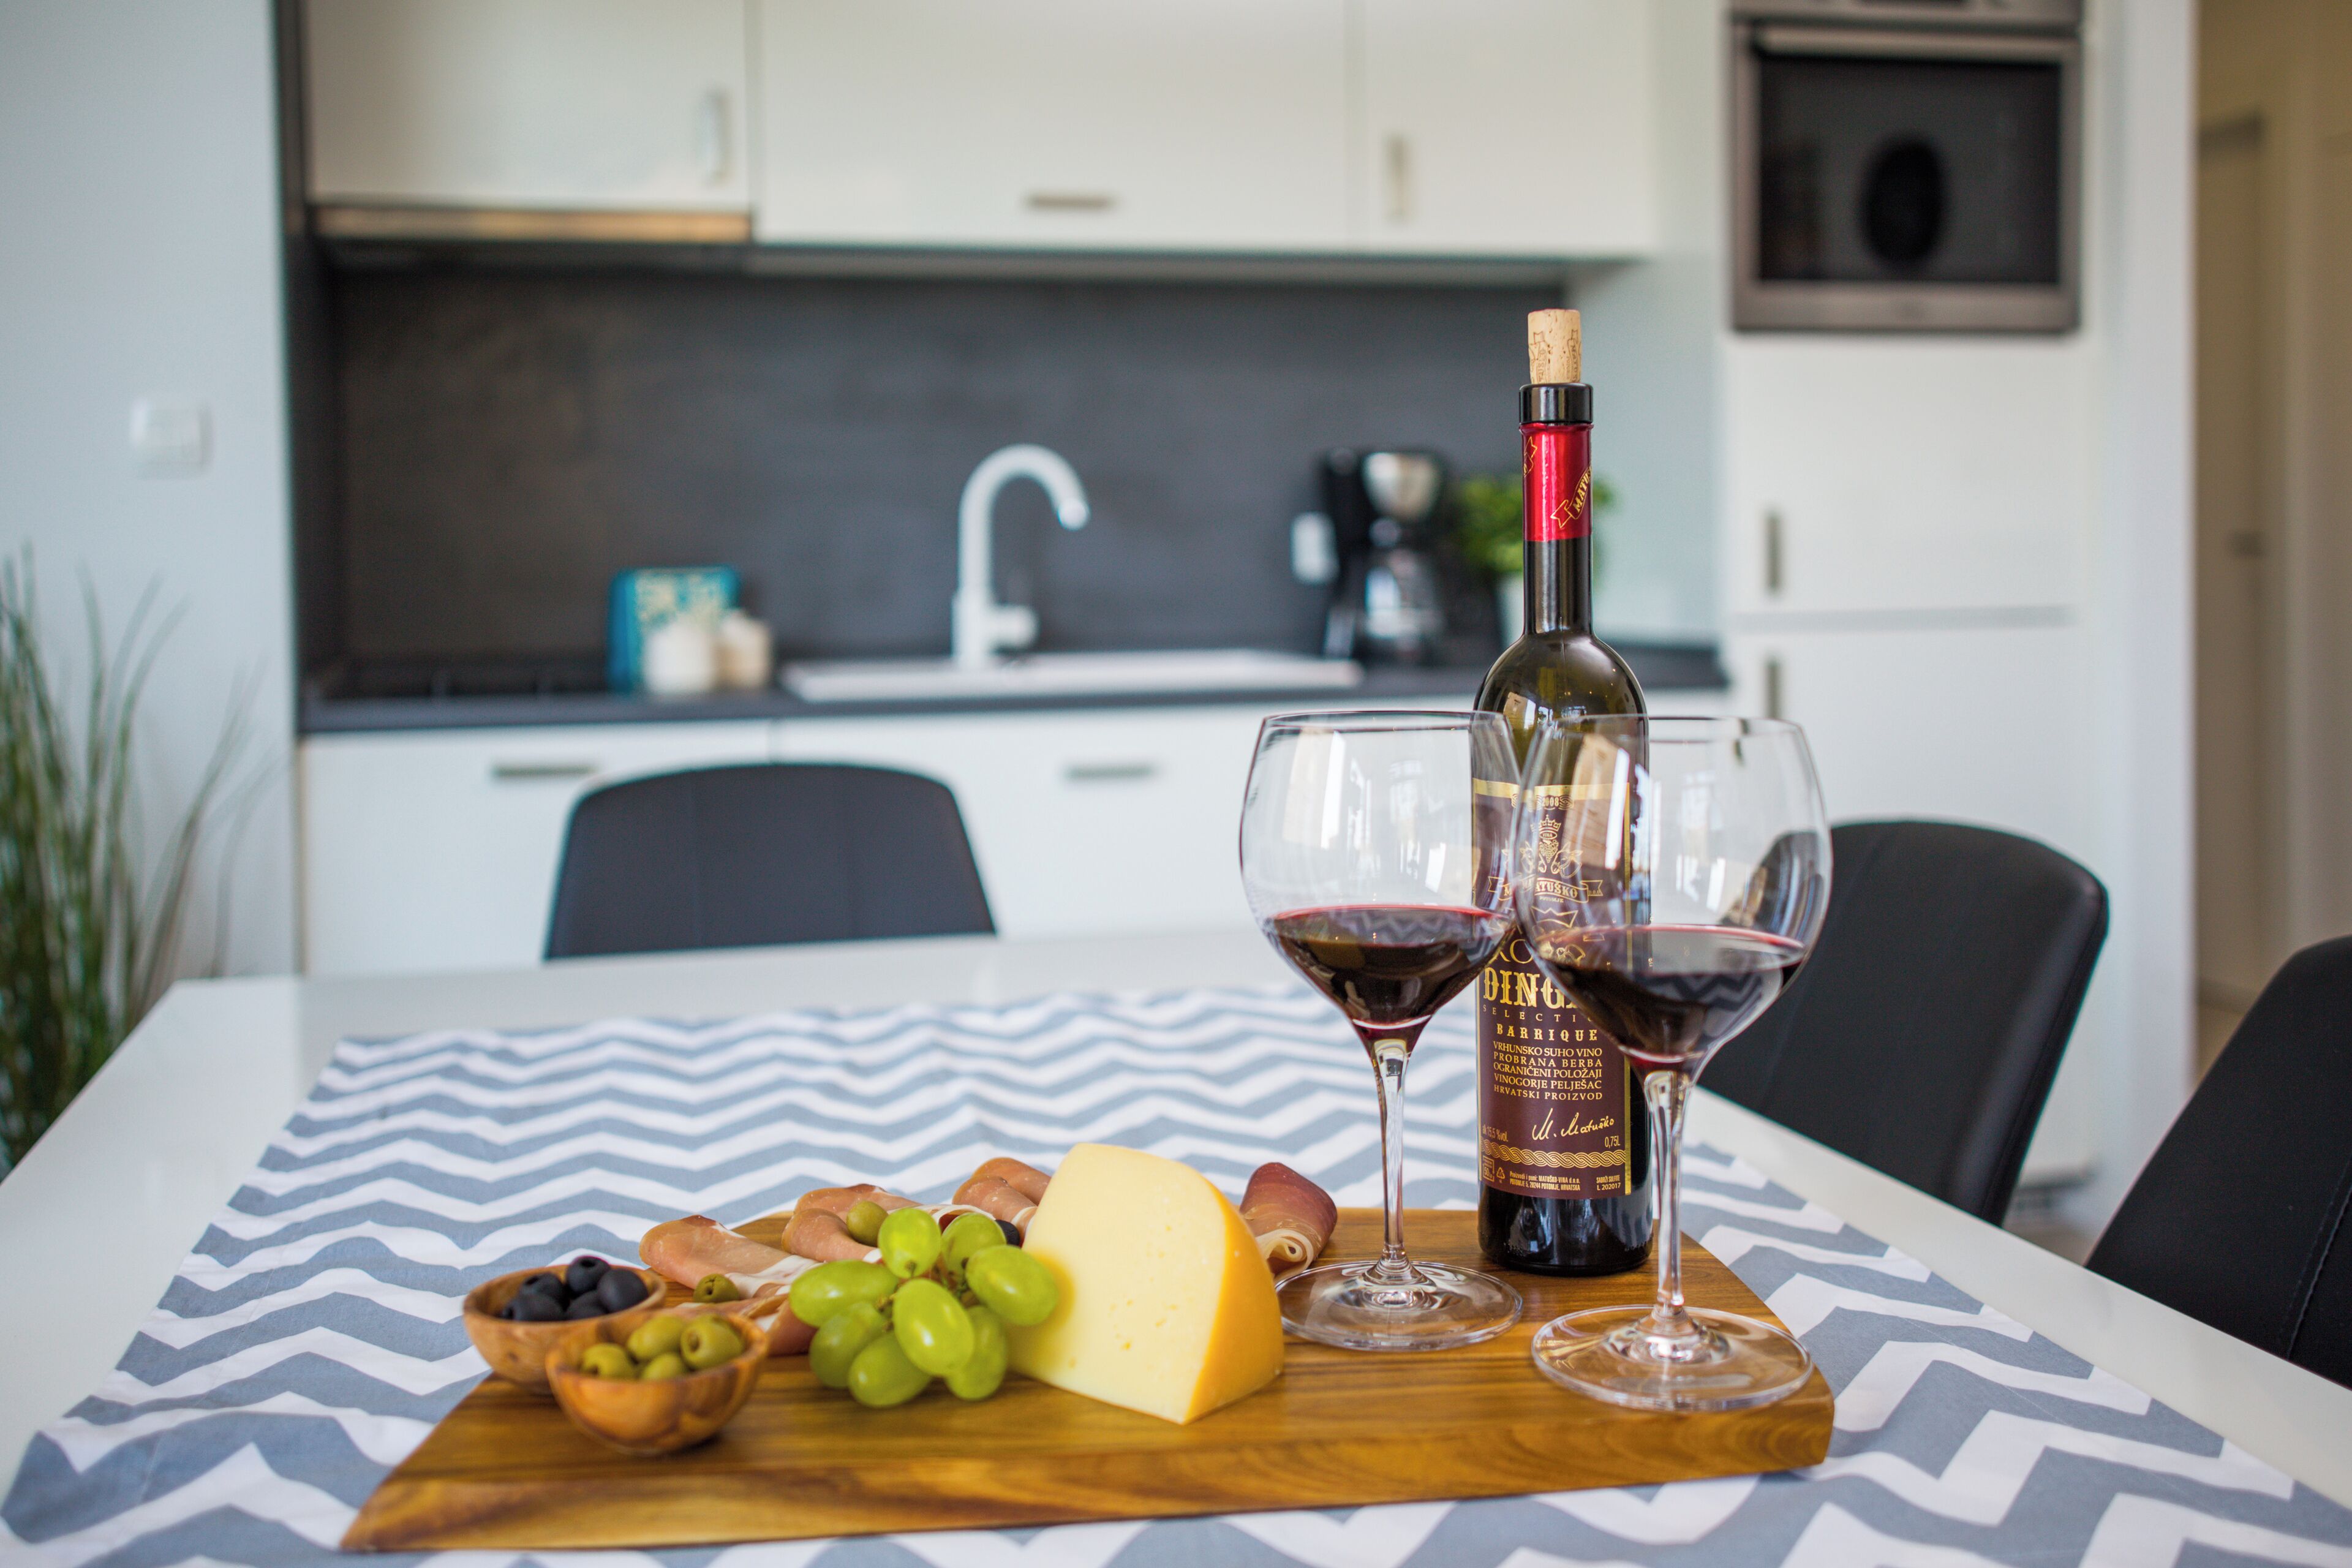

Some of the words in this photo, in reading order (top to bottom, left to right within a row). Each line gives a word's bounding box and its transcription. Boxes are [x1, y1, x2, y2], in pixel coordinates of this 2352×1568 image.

[1483, 967, 1578, 1009] DING
[1483, 1005, 1593, 1022] SELECTI
[1496, 1023, 1597, 1042] BARRIQUE
[1493, 1041, 1542, 1056] VRHUNSKO
[1544, 1047, 1574, 1057] SUHO
[1576, 1048, 1602, 1057] VINO
[1493, 1052, 1556, 1067] PROBRANA
[1562, 1059, 1602, 1068] BERBA
[1493, 1061, 1551, 1077] OGRANIČENI
[1553, 1068, 1602, 1079] POLOŽAJI
[1494, 1072, 1548, 1090] VINOGORJE
[1550, 1079, 1602, 1091] PELJEŠAC
[1494, 1084, 1540, 1099] HRVATSKI
[1544, 1091, 1602, 1101] PROIZVOD
[1604, 1135, 1621, 1148] 0,75L
[1601, 1182, 1621, 1191] 202017
